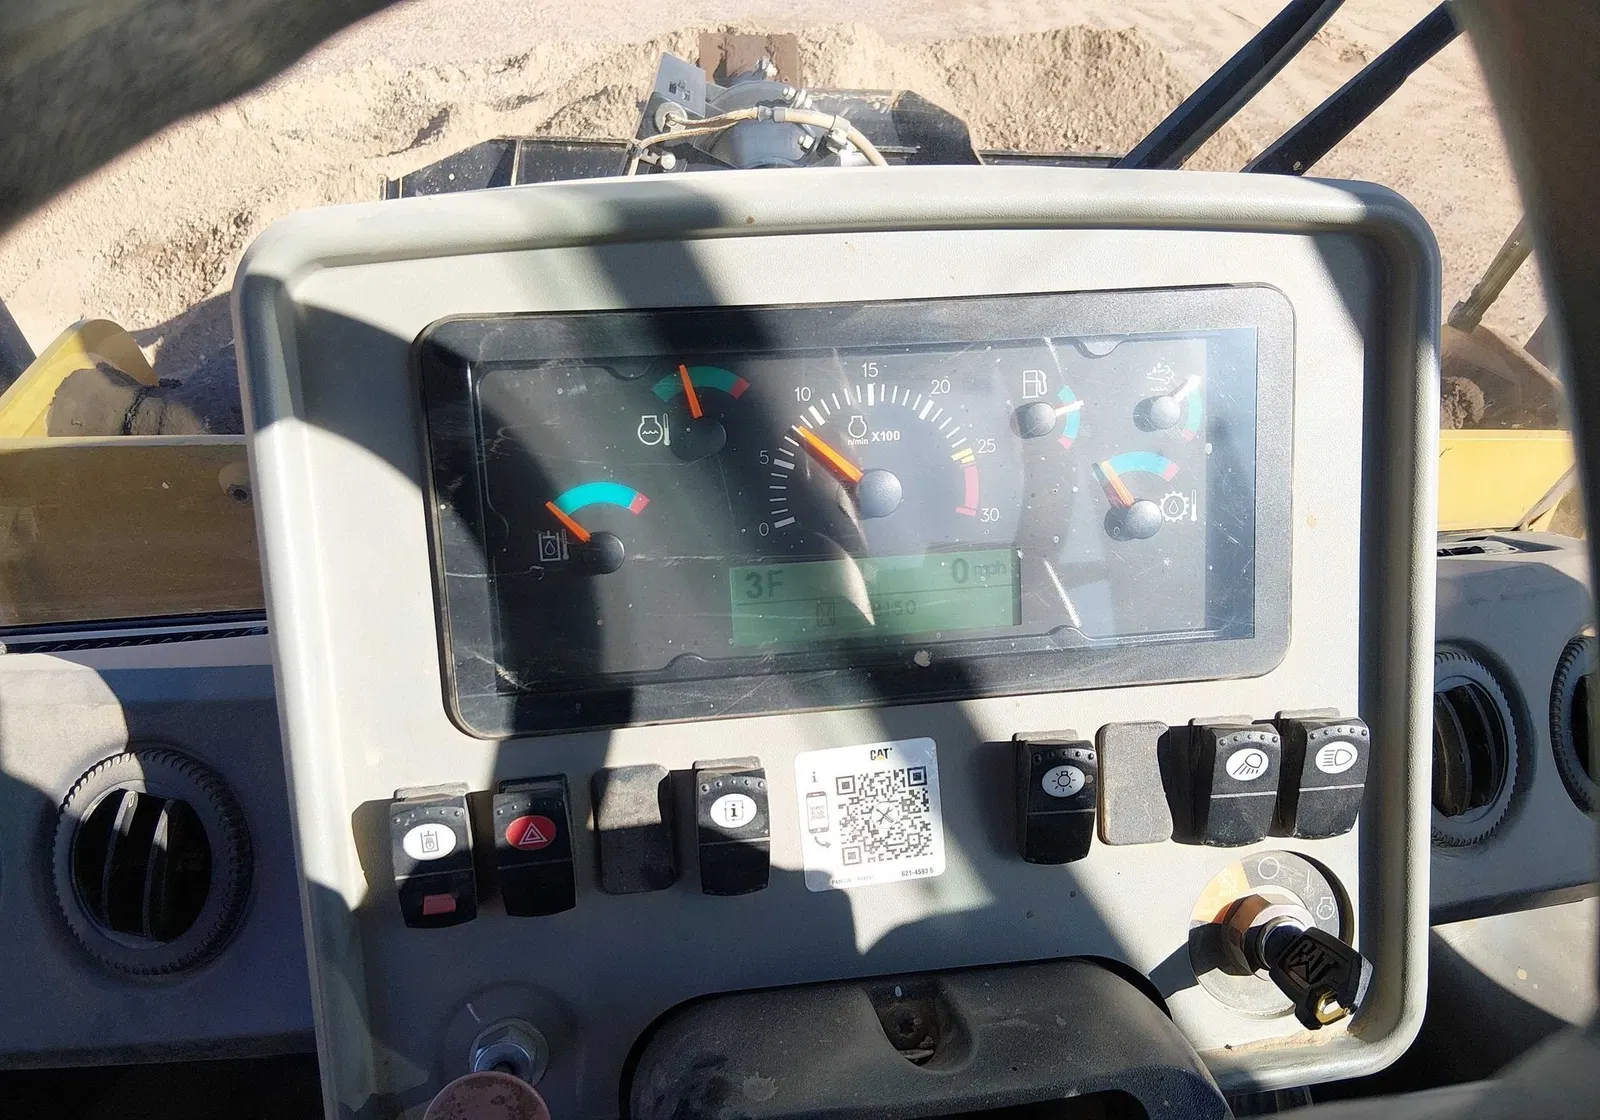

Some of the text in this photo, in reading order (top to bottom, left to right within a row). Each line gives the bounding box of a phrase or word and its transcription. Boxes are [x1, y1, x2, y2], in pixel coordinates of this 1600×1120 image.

[861, 362, 879, 378] 15
[793, 386, 812, 401] 10
[930, 379, 951, 394] 20
[871, 430, 901, 442] X100
[977, 438, 996, 454] 25
[759, 450, 769, 465] 5
[979, 507, 1000, 523] 30
[758, 522, 770, 537] 0
[951, 557, 970, 584] 0
[744, 569, 783, 600] 3F
[869, 747, 890, 761] CAT
[1288, 939, 1336, 984] CAT
